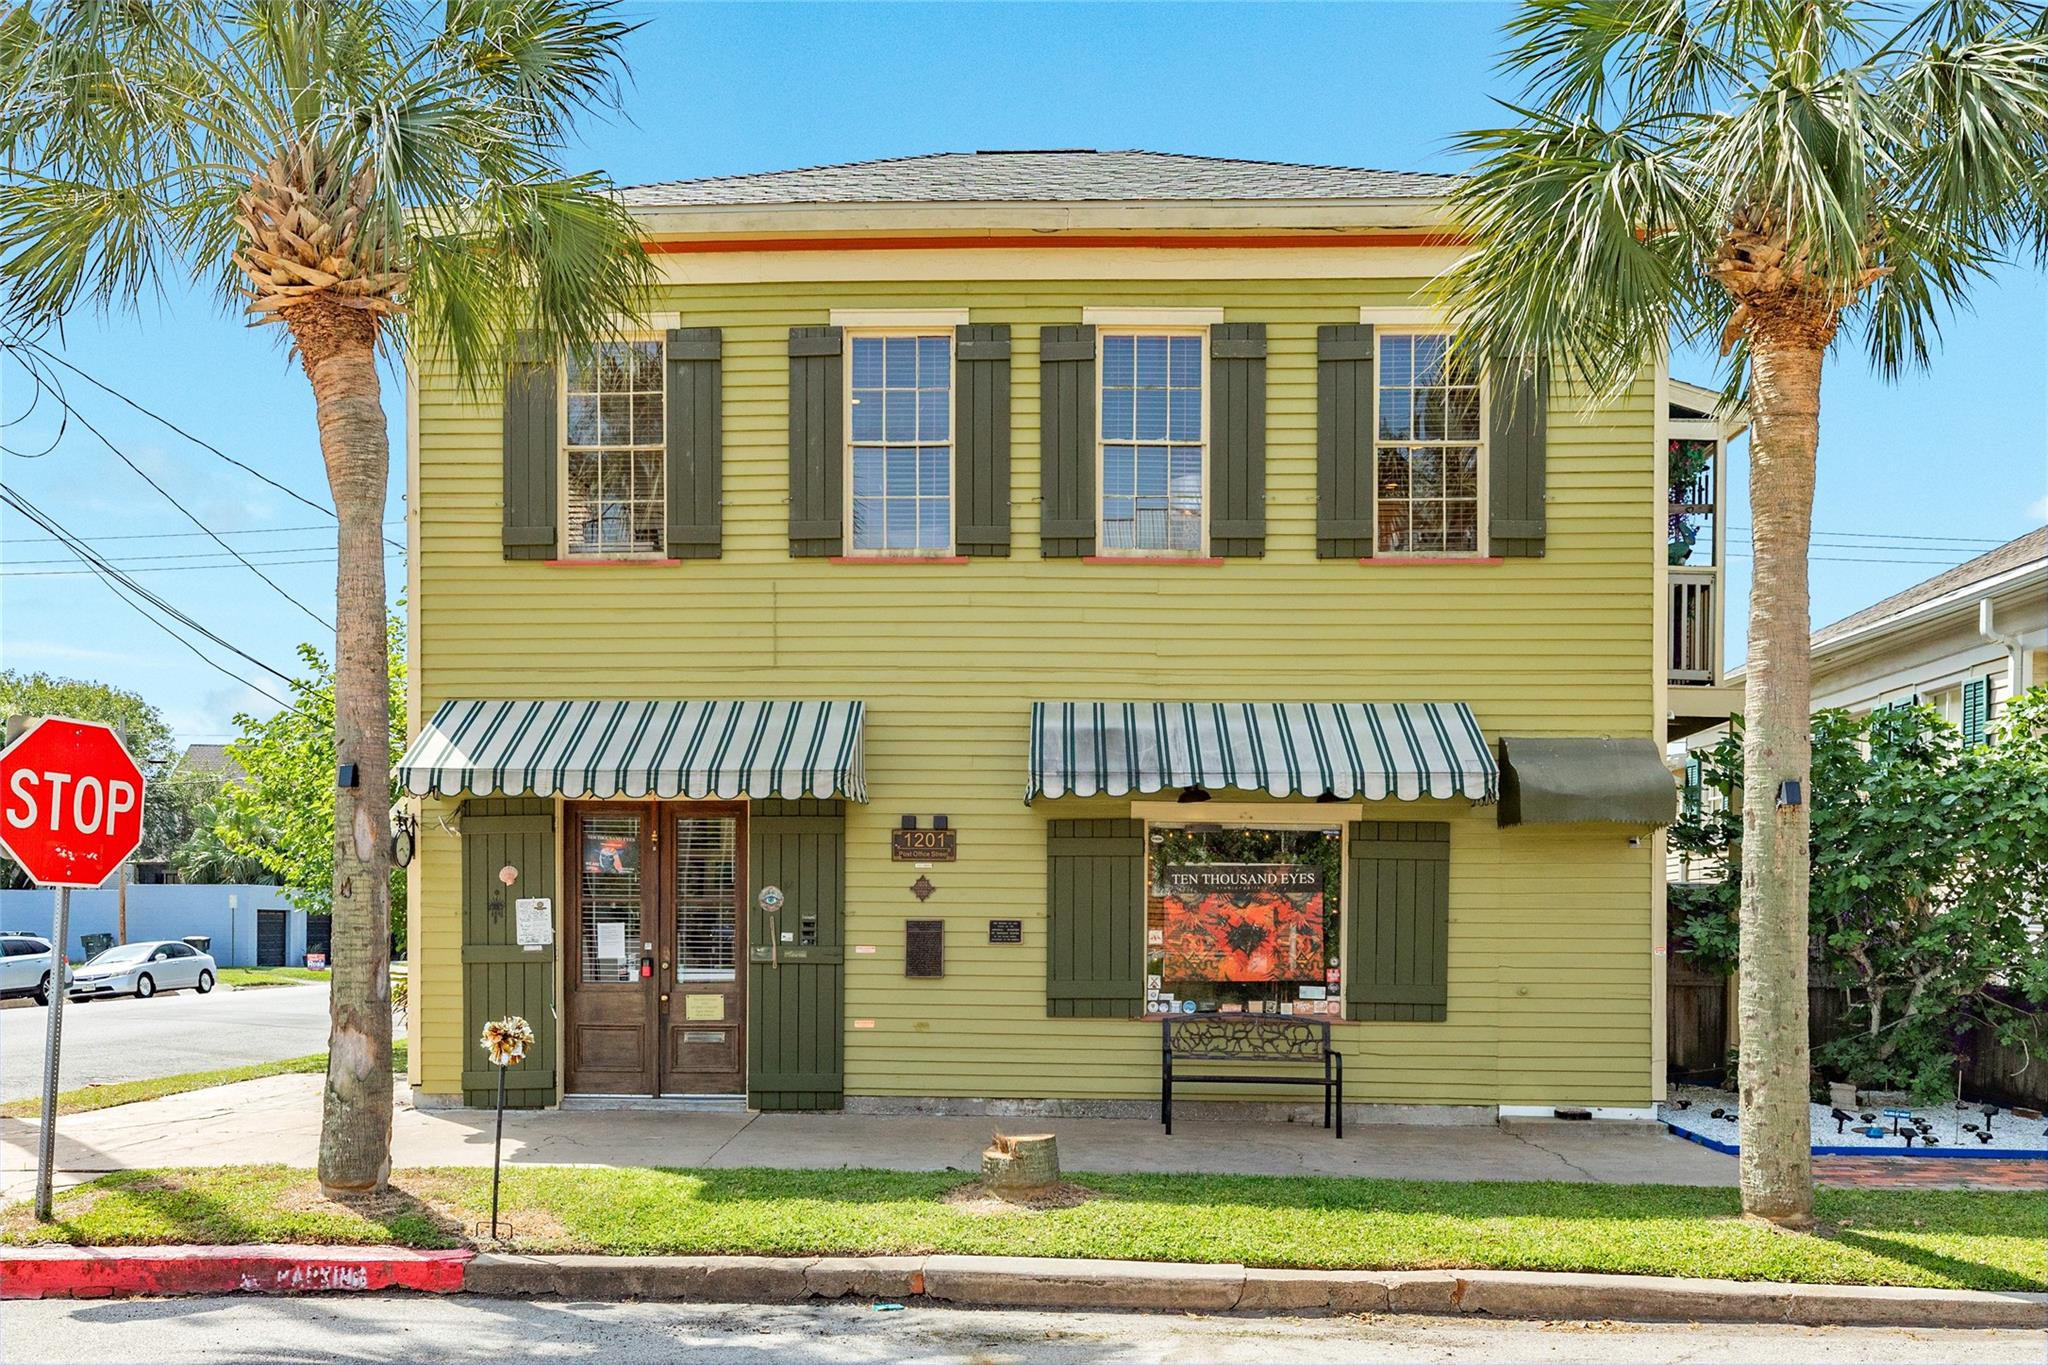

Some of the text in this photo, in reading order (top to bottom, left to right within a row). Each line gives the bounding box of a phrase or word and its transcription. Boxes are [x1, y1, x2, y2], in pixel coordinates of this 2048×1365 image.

[6, 768, 135, 836] STOP
[904, 832, 945, 848] 1201
[898, 850, 912, 858] Post
[912, 850, 930, 858] Office
[1171, 872, 1316, 885] TEN THOUSAND EYES
